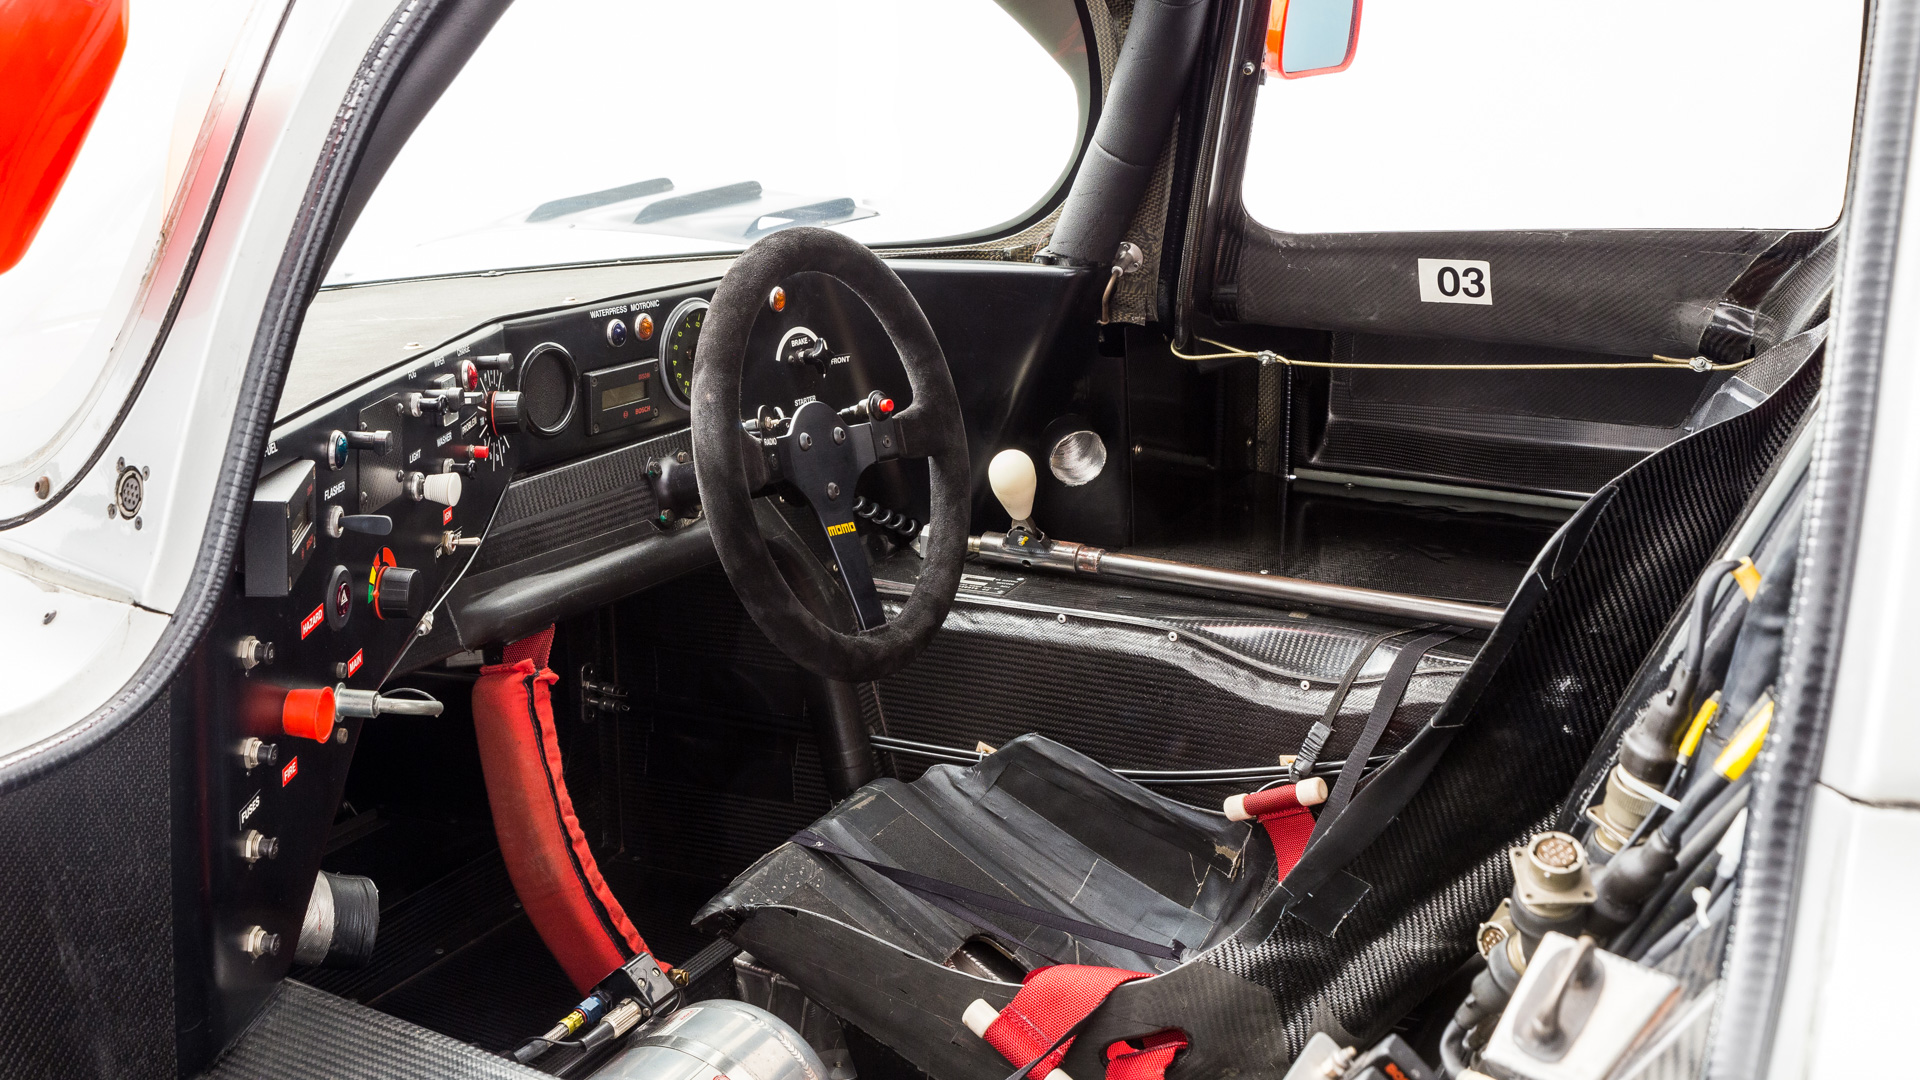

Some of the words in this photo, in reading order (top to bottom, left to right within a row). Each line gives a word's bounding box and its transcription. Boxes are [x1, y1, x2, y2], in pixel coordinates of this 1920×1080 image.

[1437, 266, 1486, 298] 03
[590, 305, 628, 319] WATERPRESS
[630, 300, 660, 311] MOTRONIC
[791, 337, 809, 347] BRAKE
[434, 357, 446, 368] WIPER
[831, 355, 851, 365] FRONT
[408, 372, 417, 380] FOG
[794, 395, 817, 407] STARTER
[635, 405, 651, 415] BOSCH
[436, 431, 453, 448] WASHER
[763, 437, 778, 446] RADIO
[409, 449, 422, 464] LIGHT
[324, 481, 346, 501] FLASHER
[444, 509, 452, 521] IGN
[436, 546, 442, 558] ON
[303, 609, 324, 635] HAZARD
[349, 655, 362, 673] MAIN
[284, 763, 297, 781] FIRE
[241, 795, 260, 824] FUSES
